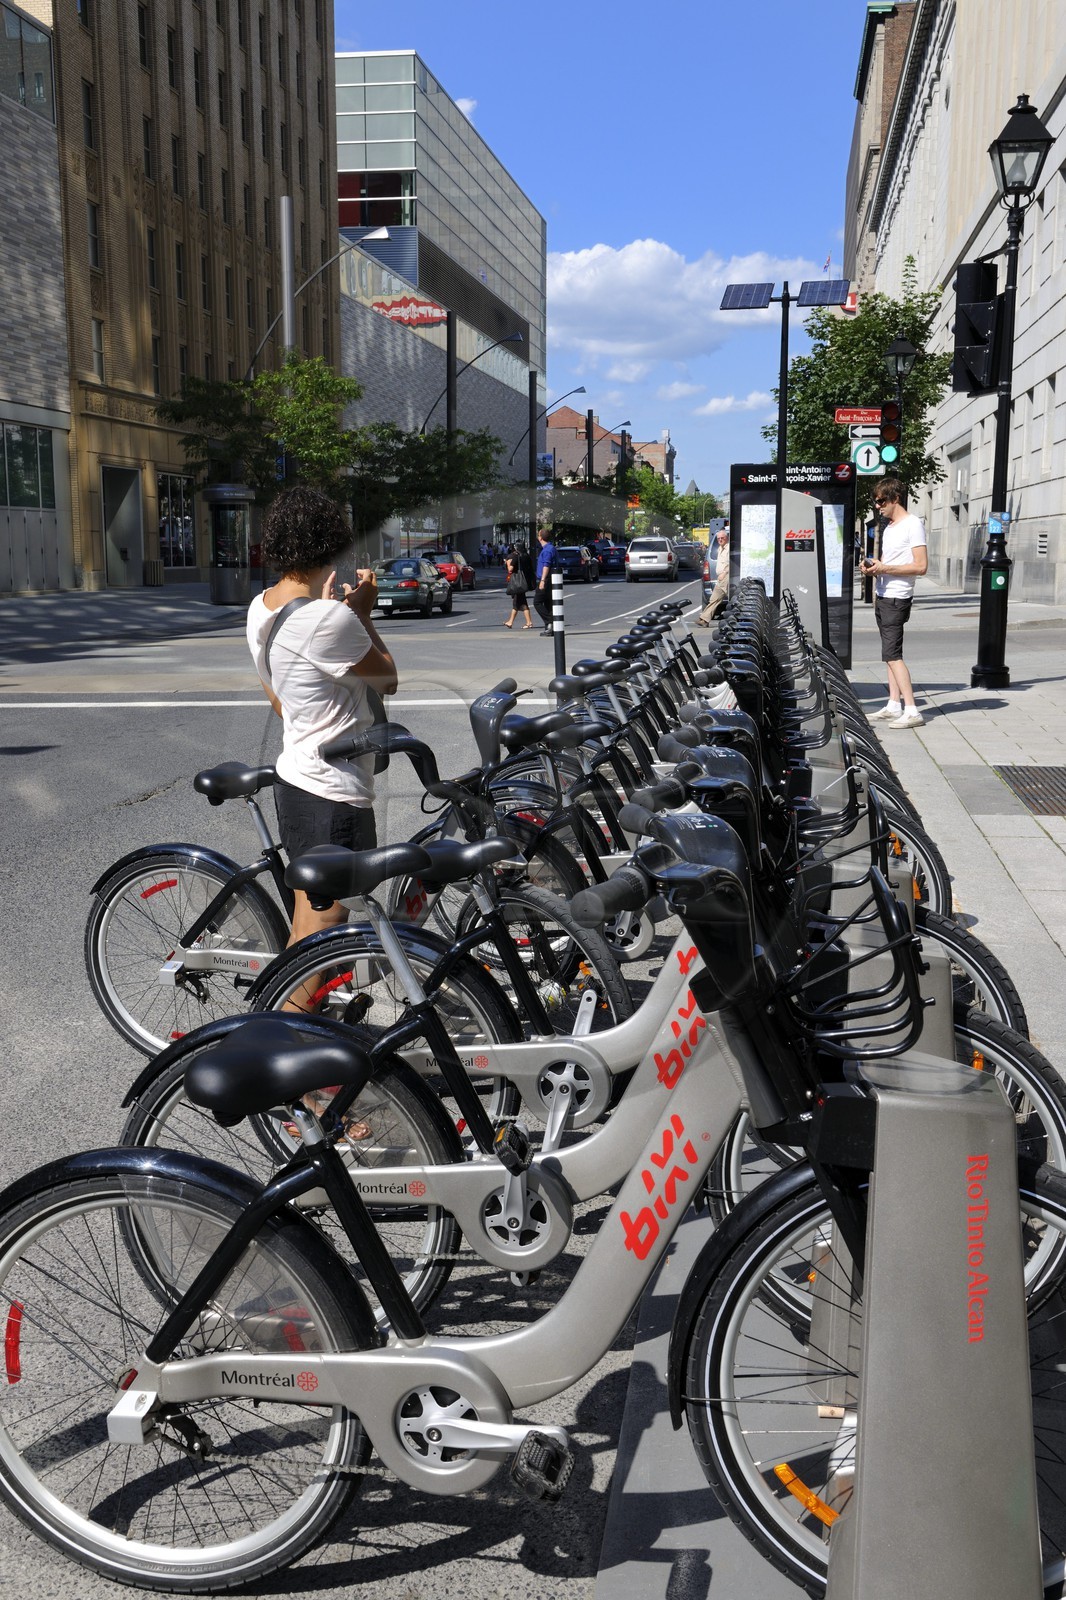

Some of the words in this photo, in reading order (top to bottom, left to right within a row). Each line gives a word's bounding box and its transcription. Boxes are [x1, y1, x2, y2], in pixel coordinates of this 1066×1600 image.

[747, 474, 831, 484] Saint-Fçois-Xavier
[786, 466, 832, 474] int-Antoine
[213, 956, 249, 968] Montréal
[653, 989, 707, 1090] bix
[619, 1114, 699, 1261] bixi
[967, 1269, 989, 1344] Alcan
[221, 1370, 295, 1388] Montréal
